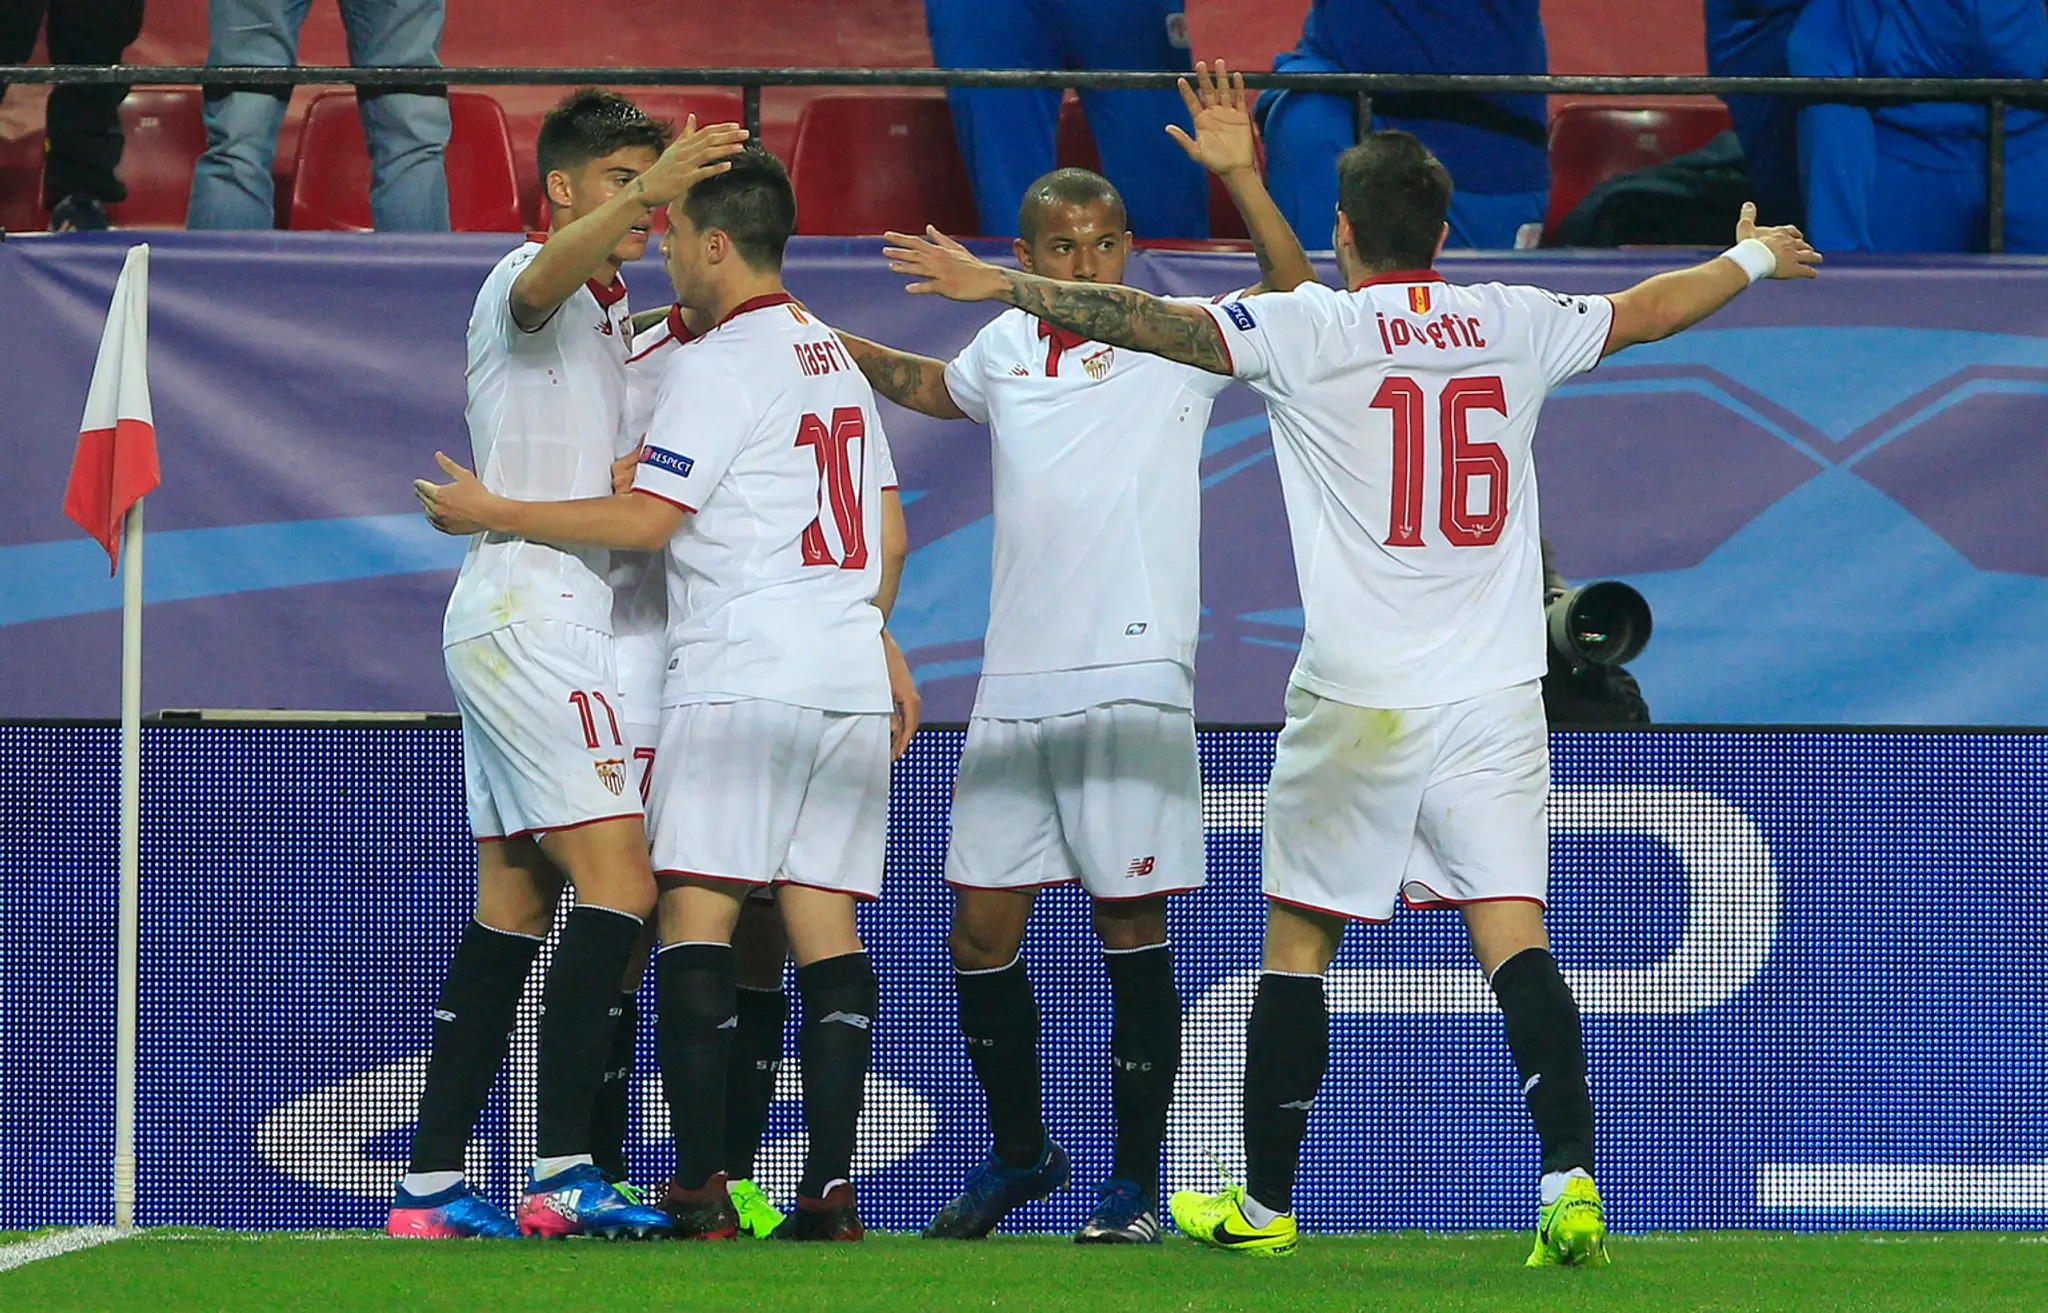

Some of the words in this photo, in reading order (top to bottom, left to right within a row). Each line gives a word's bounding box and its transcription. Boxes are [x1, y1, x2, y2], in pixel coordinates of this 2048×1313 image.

[794, 332, 850, 376] nasri
[650, 452, 691, 472] RESPECT
[794, 407, 868, 570] 10
[1369, 376, 1509, 547] 16
[568, 690, 623, 749] 11
